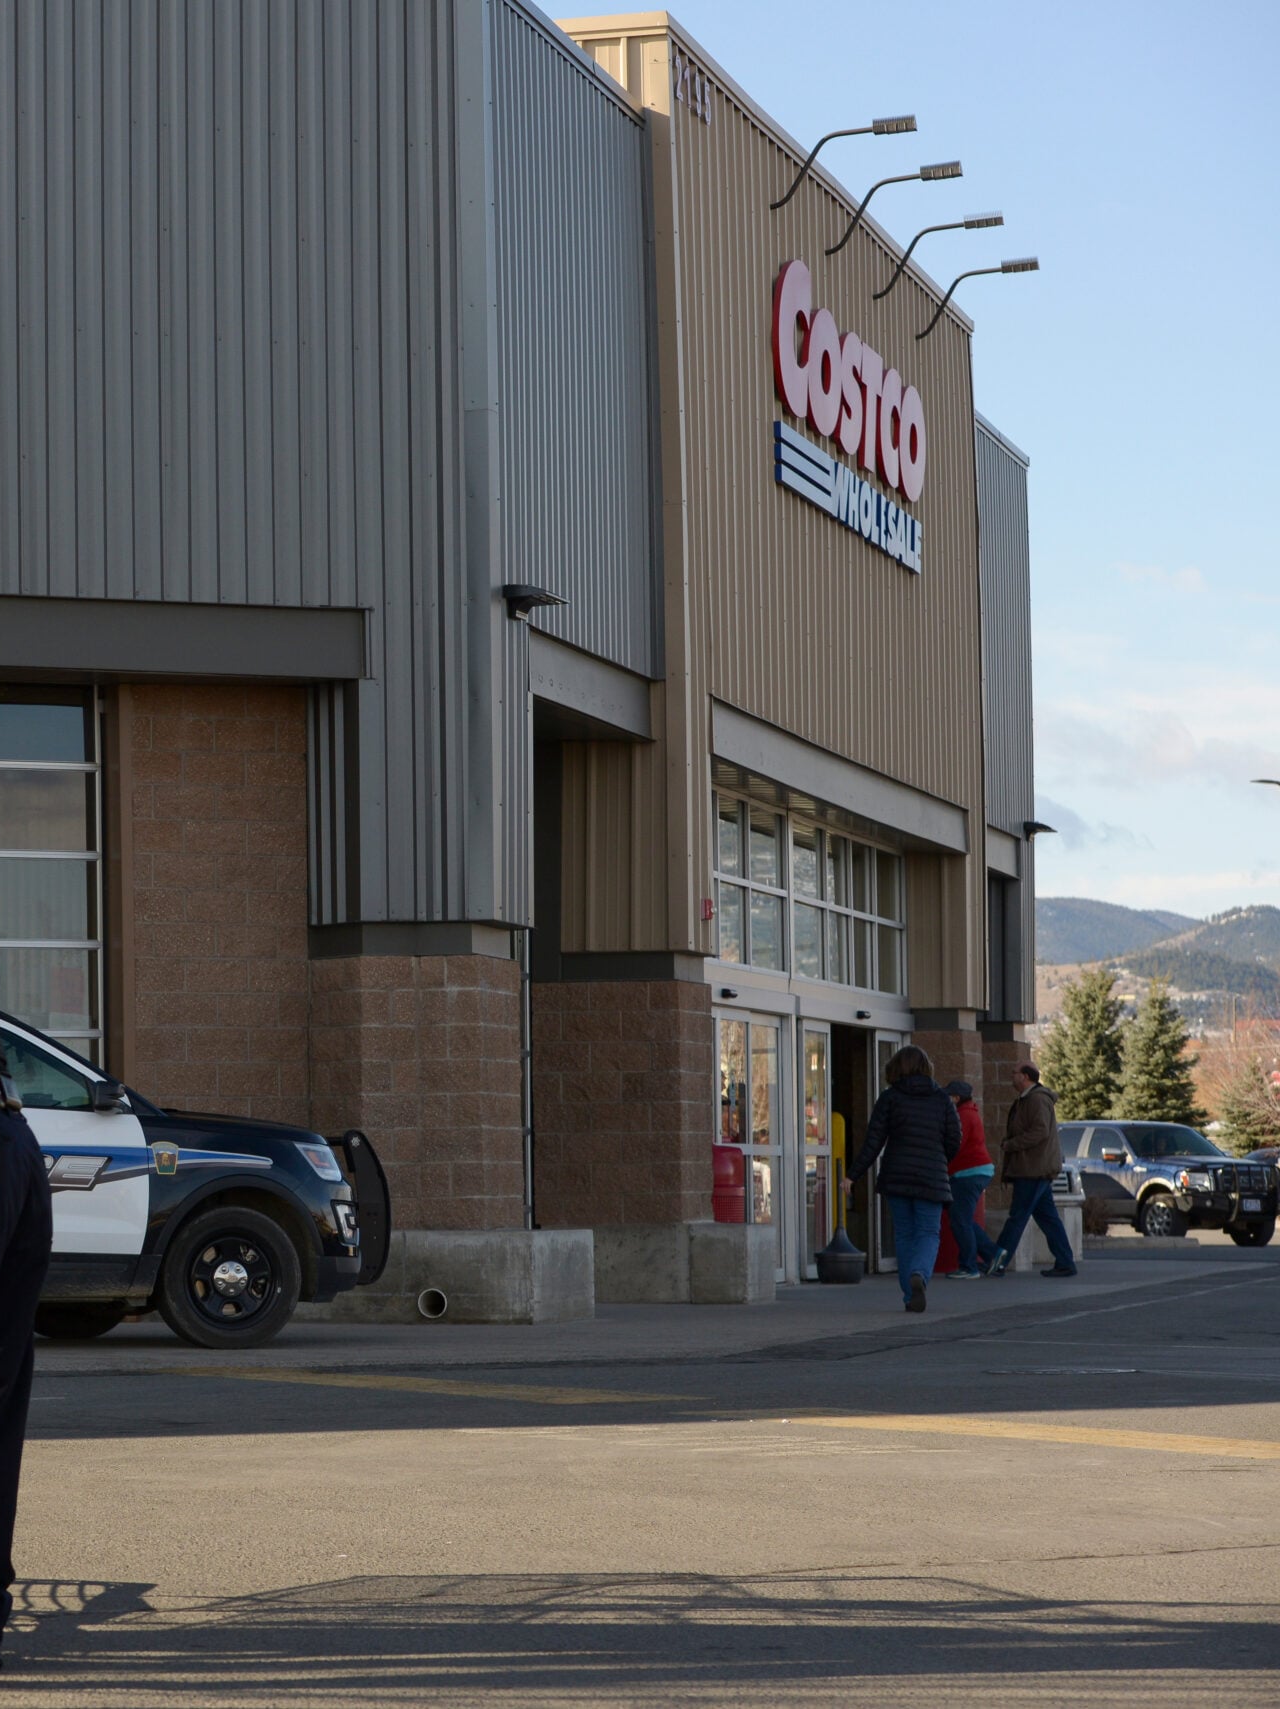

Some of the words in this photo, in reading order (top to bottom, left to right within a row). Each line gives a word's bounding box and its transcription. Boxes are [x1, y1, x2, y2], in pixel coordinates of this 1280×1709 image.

[675, 55, 712, 127] 2195
[773, 259, 926, 502] COSTCO
[833, 460, 923, 575] WHOLESALE
